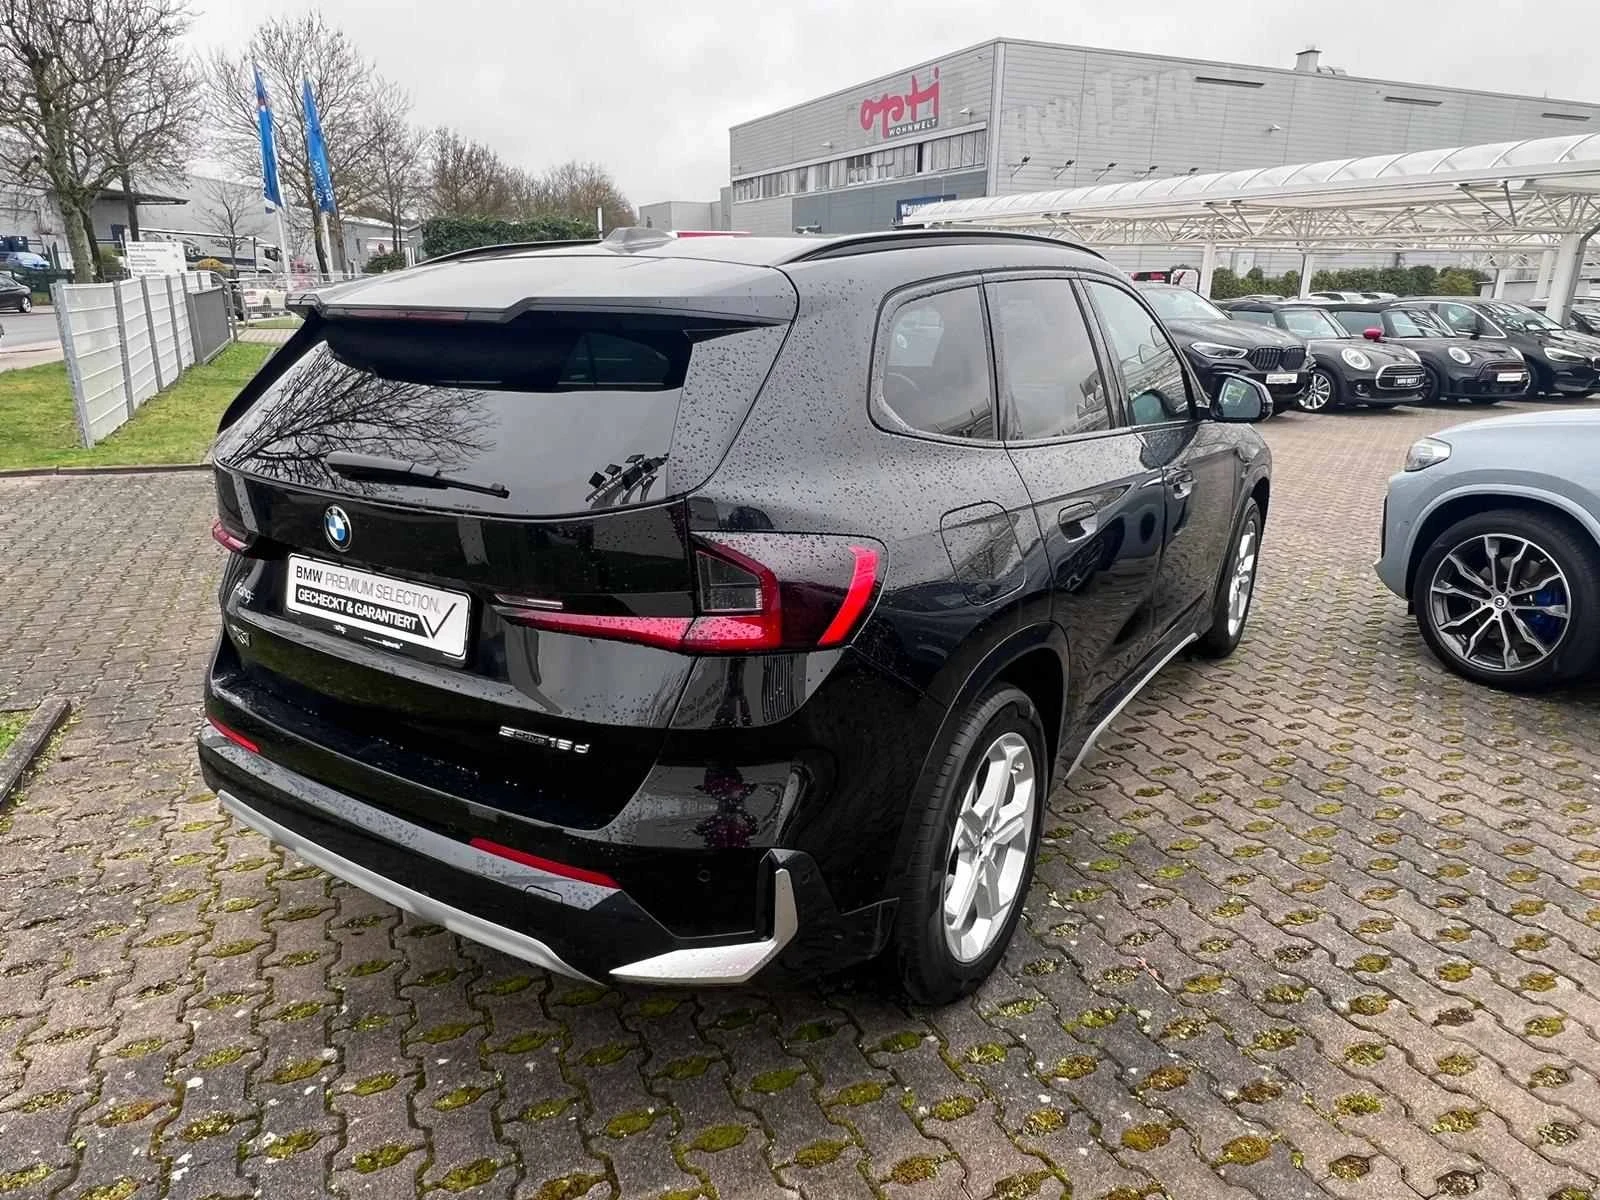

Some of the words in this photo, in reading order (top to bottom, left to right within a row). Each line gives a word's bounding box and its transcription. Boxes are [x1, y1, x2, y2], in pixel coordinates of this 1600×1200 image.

[861, 67, 939, 139] opti
[888, 118, 937, 136] WOHNWELT
[296, 565, 323, 583] BMW
[325, 571, 374, 596] PREMIUM
[298, 589, 346, 611] GECHECKT
[346, 600, 354, 613] &
[354, 603, 418, 630] GARANTIERT
